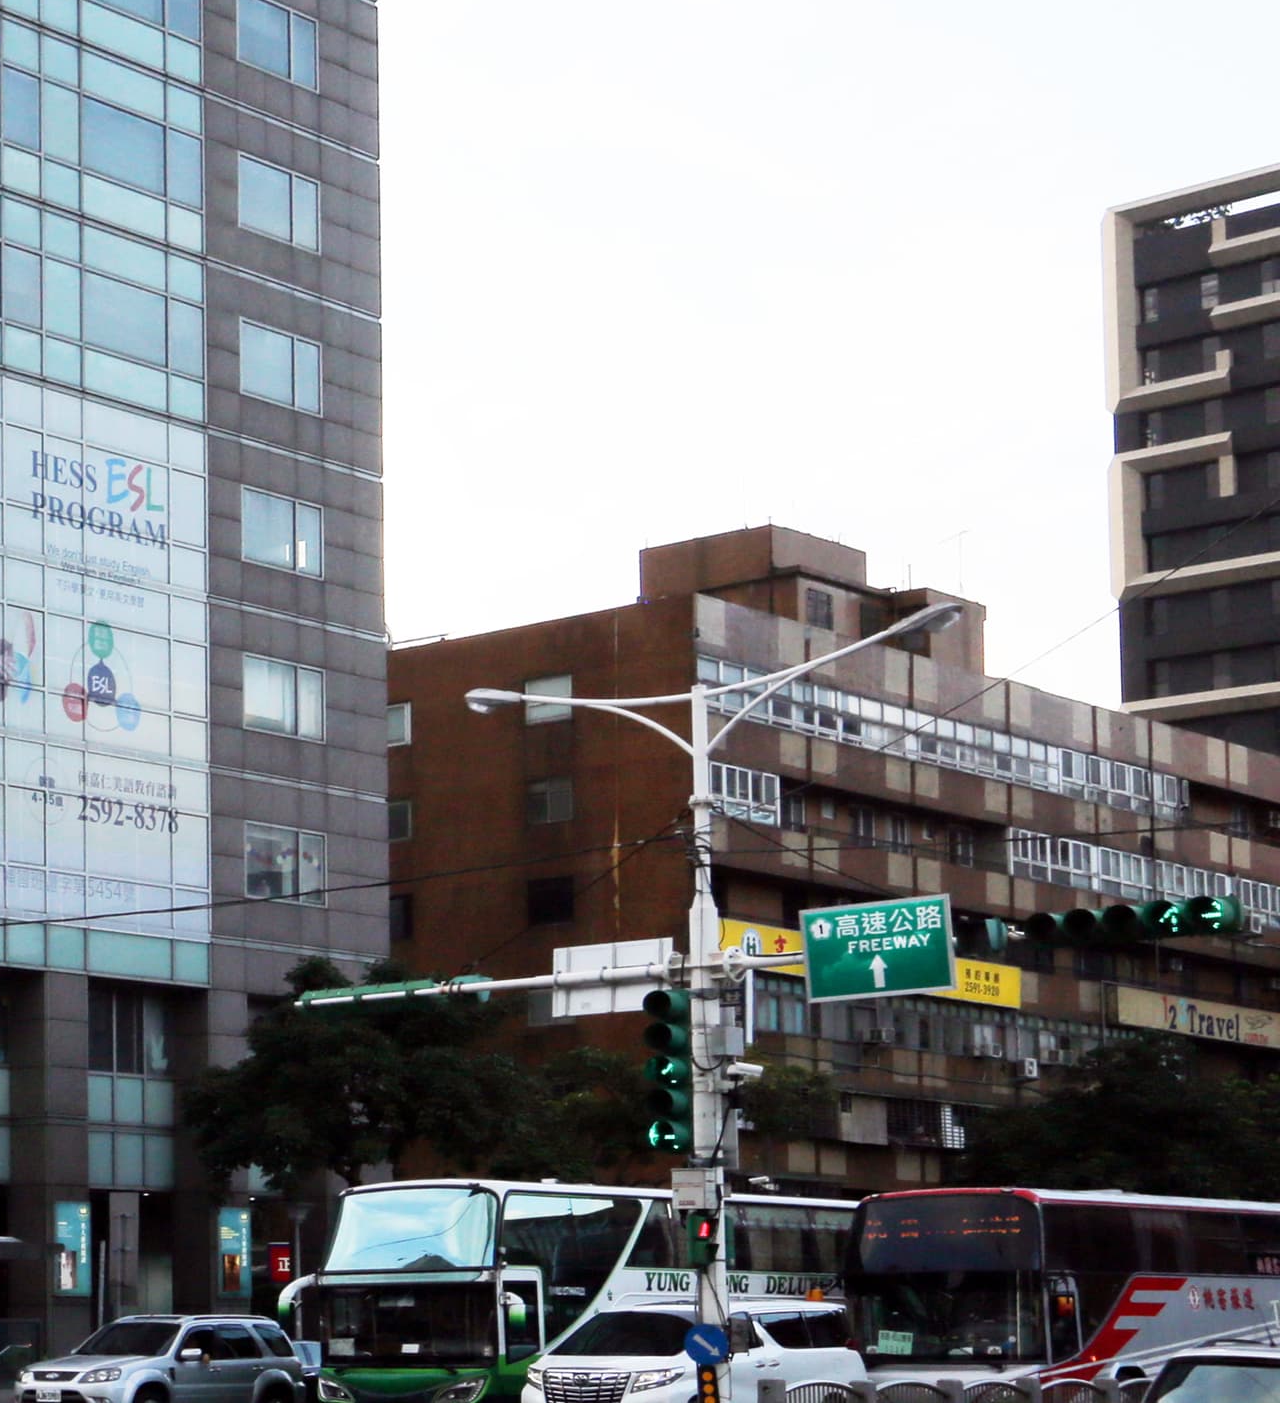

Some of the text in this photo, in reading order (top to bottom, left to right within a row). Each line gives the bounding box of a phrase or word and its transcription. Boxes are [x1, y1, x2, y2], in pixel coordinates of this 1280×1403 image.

[31, 450, 165, 513] HESS ESL
[31, 490, 167, 551] PROGRAM
[91, 675, 113, 694] ESL
[77, 794, 179, 835] 2592-8378
[835, 904, 943, 939] 高速公路
[847, 933, 932, 955] FREEWAY
[1187, 1003, 1240, 1042] Travel
[645, 1272, 691, 1293] YUNG
